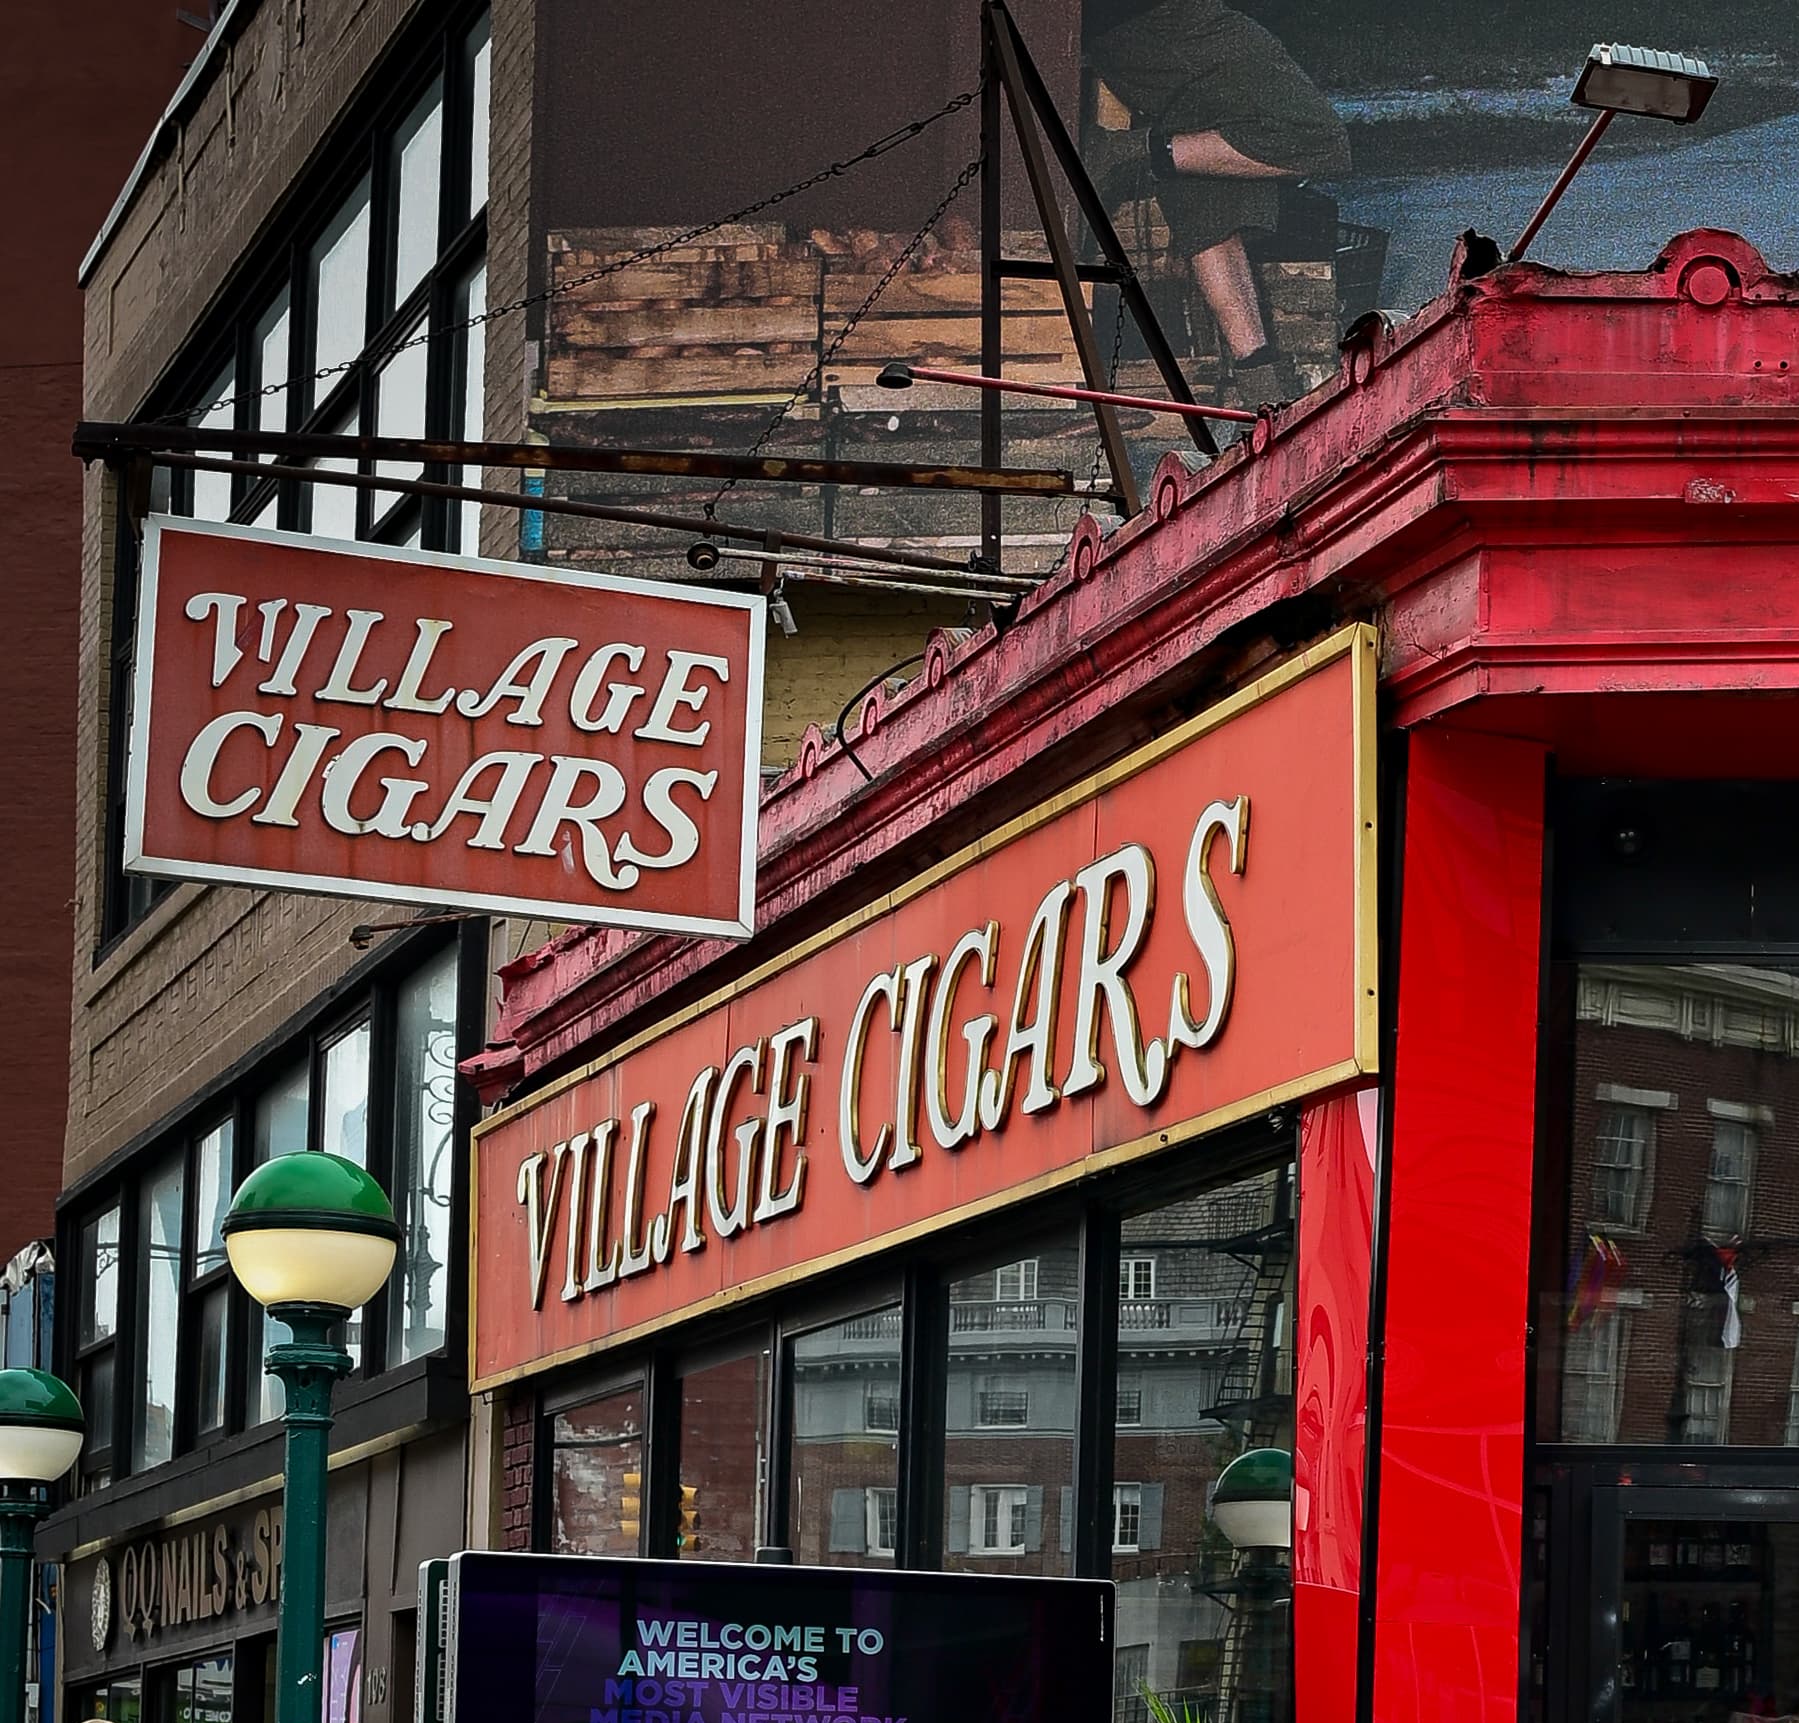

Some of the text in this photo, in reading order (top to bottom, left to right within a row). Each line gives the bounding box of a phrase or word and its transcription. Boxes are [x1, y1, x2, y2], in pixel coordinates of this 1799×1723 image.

[184, 592, 731, 748] VILLAGE
[179, 710, 720, 892] CIGARS
[516, 794, 1251, 1312] VILLAGE CIGARS
[160, 1523, 228, 1628] NAILS
[234, 1551, 248, 1611] &
[251, 1506, 285, 1605] SP
[603, 1678, 859, 1712] MOST VISIBLE
[617, 1650, 819, 1682] AMERICA'S
[636, 1619, 884, 1655] WELCOME TO
